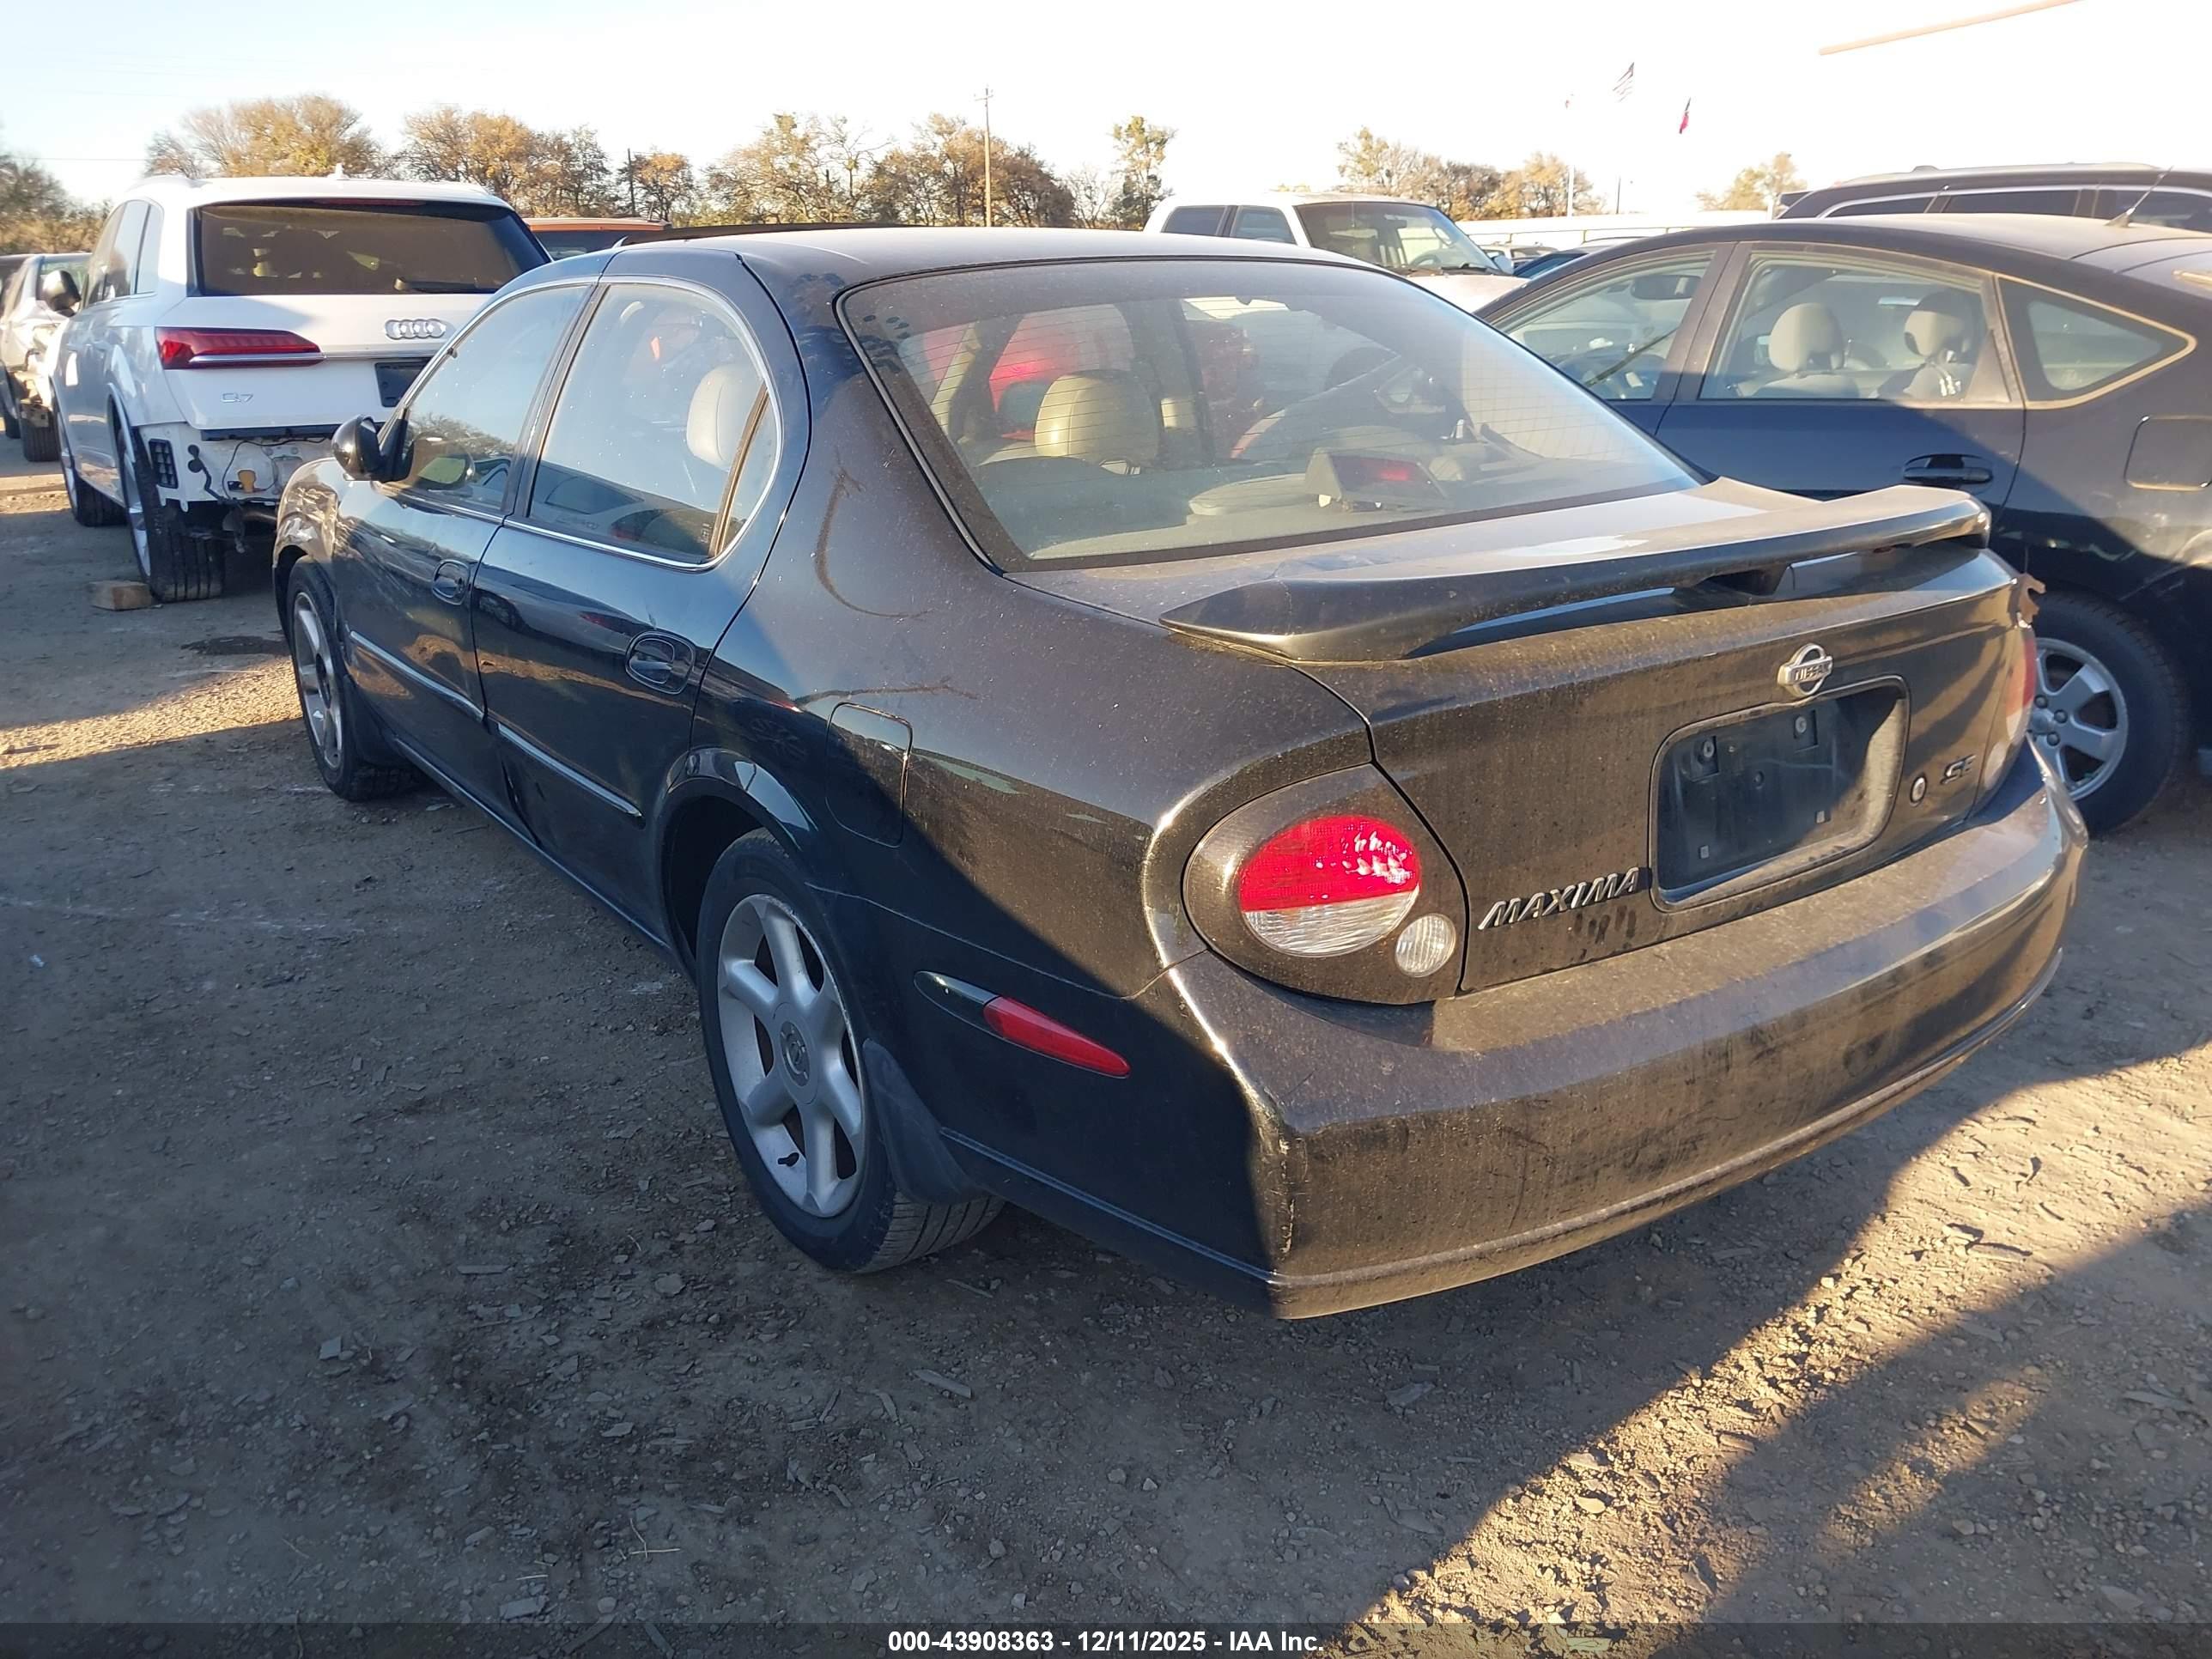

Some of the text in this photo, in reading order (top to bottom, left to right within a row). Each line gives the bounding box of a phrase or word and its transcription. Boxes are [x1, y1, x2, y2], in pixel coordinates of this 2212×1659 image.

[222, 392, 253, 404] Q7
[1941, 754, 1977, 784] SE
[1477, 866, 1639, 930] MAXIMA
